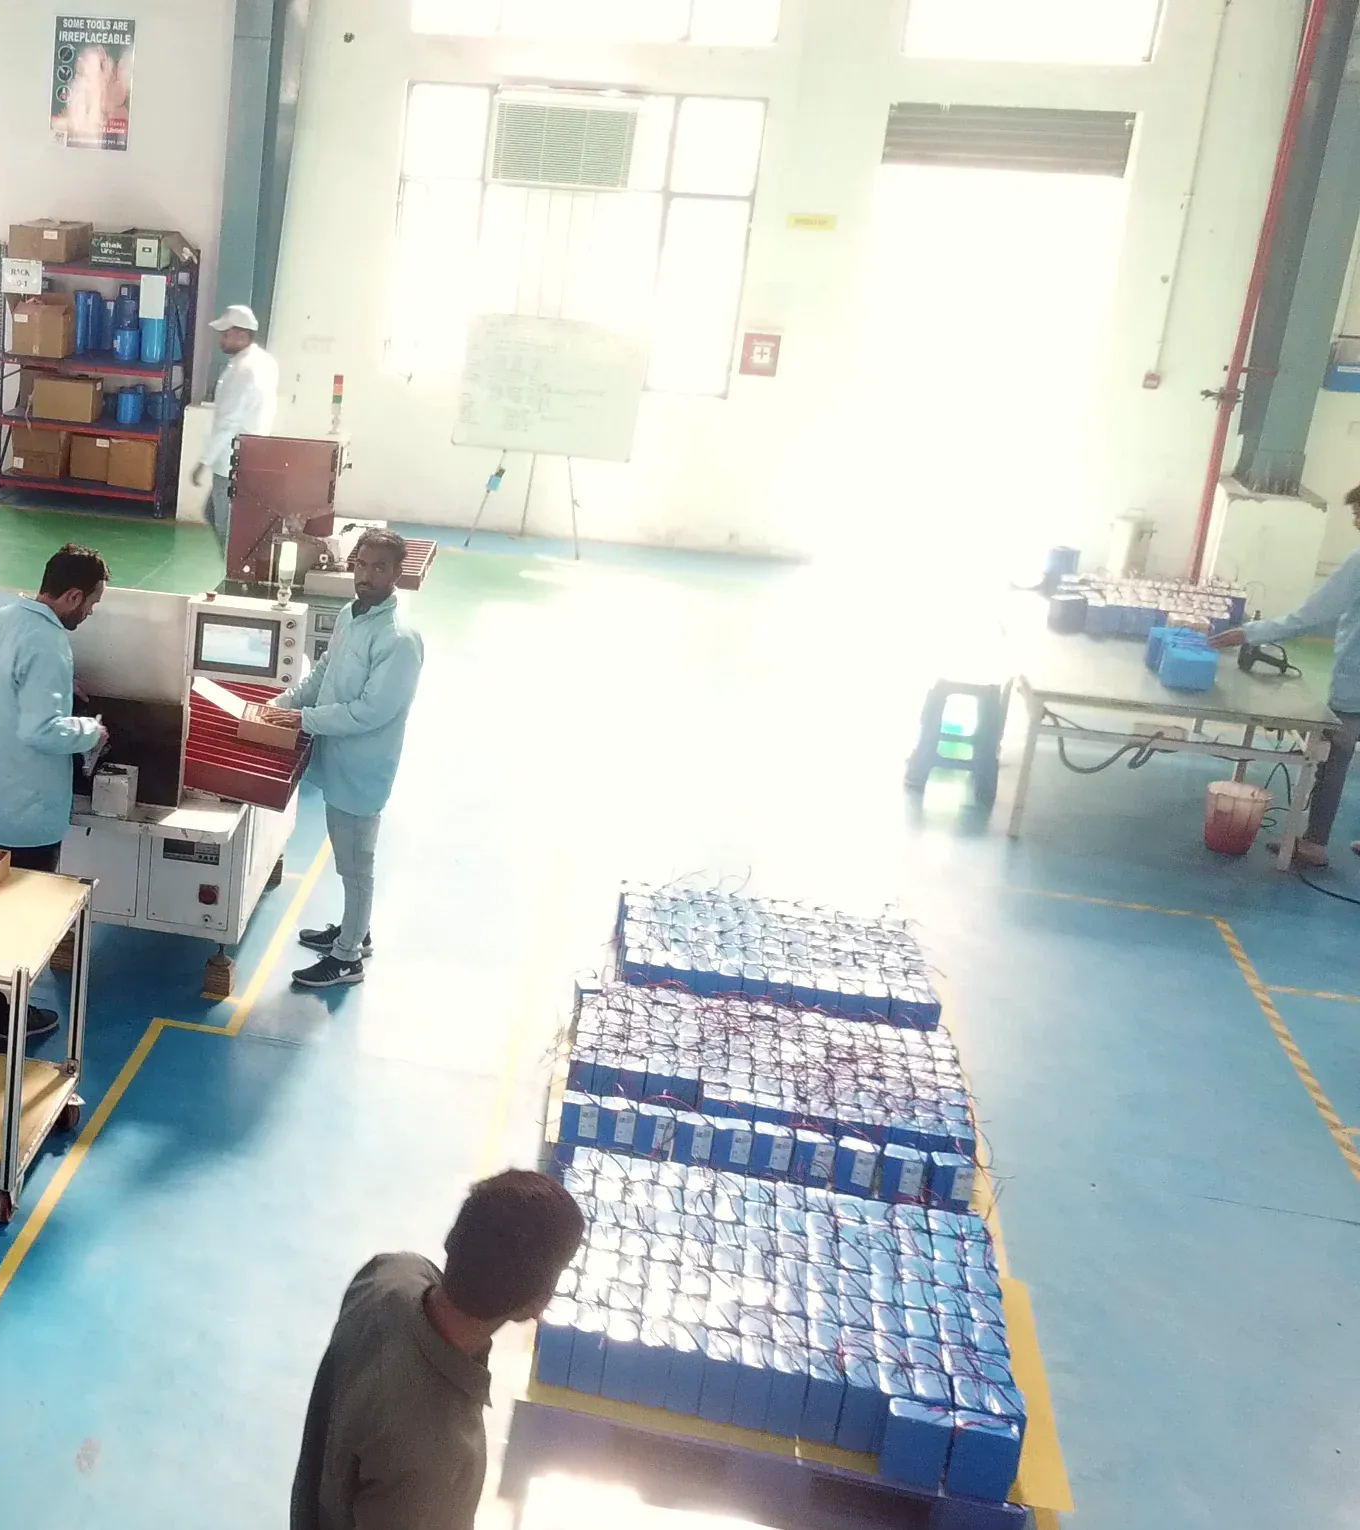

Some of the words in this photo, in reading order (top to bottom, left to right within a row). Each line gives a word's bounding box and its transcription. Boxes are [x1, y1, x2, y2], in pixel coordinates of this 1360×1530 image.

[62, 18, 85, 29] SOME
[86, 19, 111, 30] TOOLS
[112, 21, 129, 31] ARE
[58, 30, 131, 45] IRREPLACEABLE
